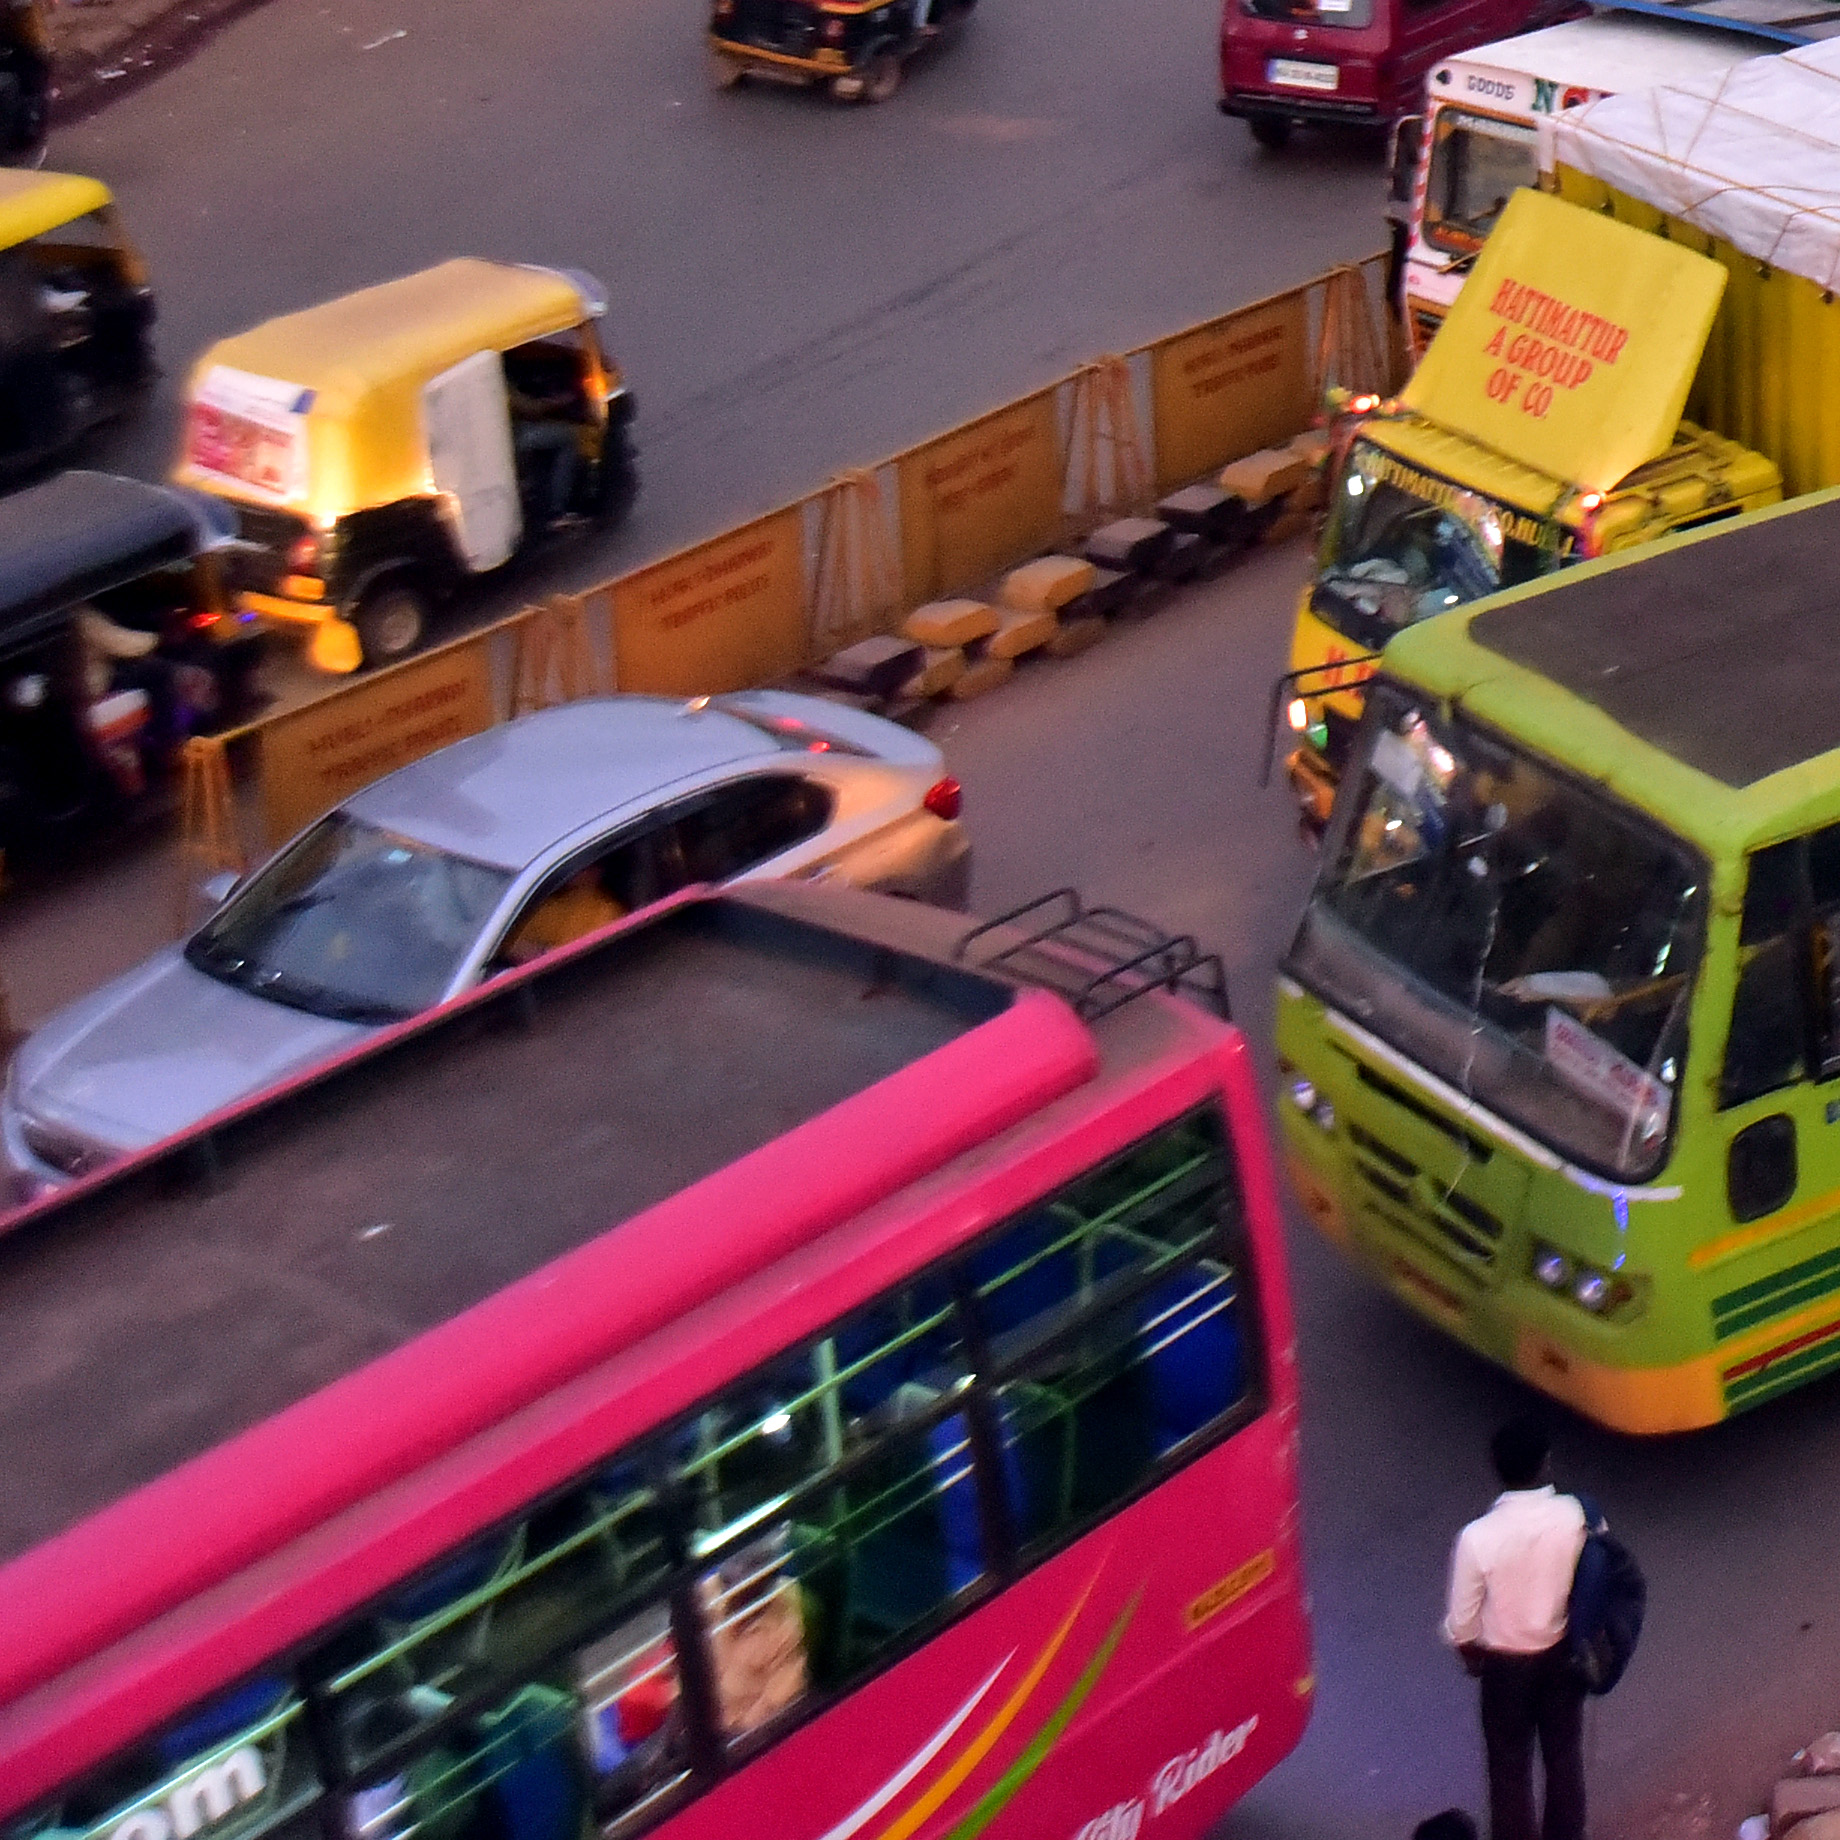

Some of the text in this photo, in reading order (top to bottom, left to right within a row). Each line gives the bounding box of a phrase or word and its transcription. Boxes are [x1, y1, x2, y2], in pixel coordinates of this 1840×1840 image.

[1466, 73, 1516, 100] GOODS
[1489, 277, 1630, 365] HATTIMATTUR
[1482, 325, 1594, 390] A GROUP
[1486, 367, 1523, 404] OF
[1152, 1713, 1261, 1819] Rider
